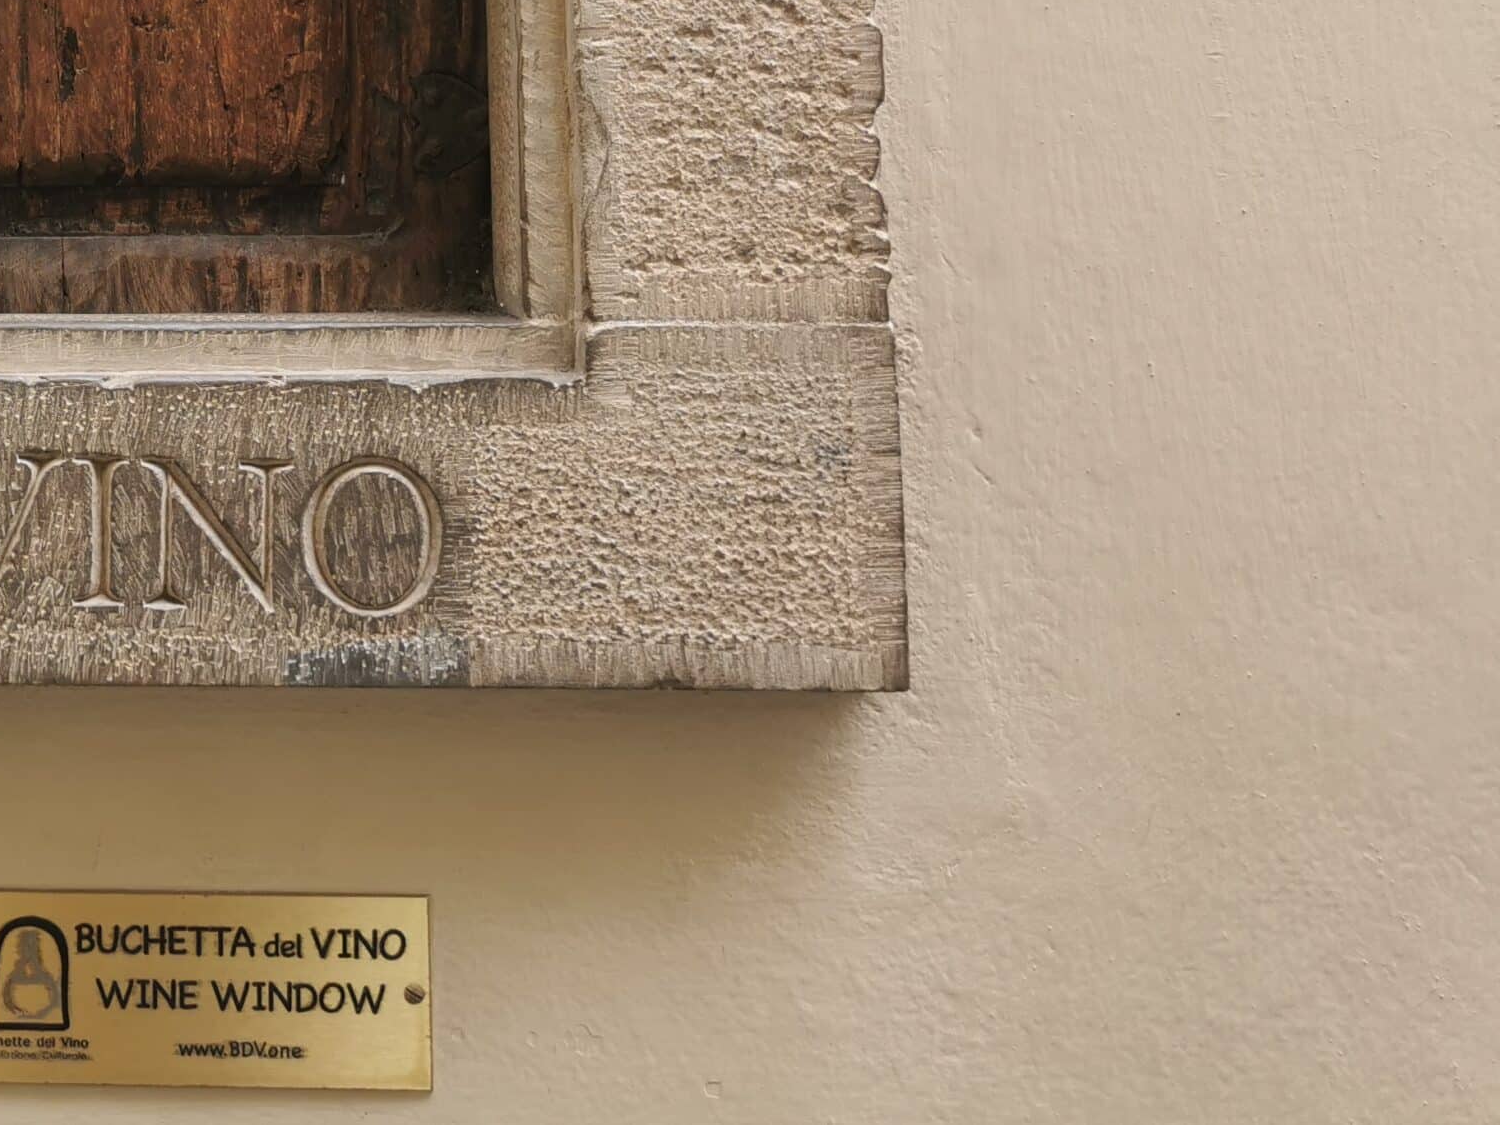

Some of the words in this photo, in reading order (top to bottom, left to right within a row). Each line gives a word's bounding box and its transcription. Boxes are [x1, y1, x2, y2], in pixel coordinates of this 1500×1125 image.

[74, 923, 256, 958] BUCHETTA
[264, 932, 303, 958] del
[309, 927, 406, 960] VINO
[96, 977, 198, 1010] WINE
[211, 980, 386, 1014] WINDOW
[61, 1037, 89, 1049] Vino
[177, 1040, 303, 1059] www.BDV.one
